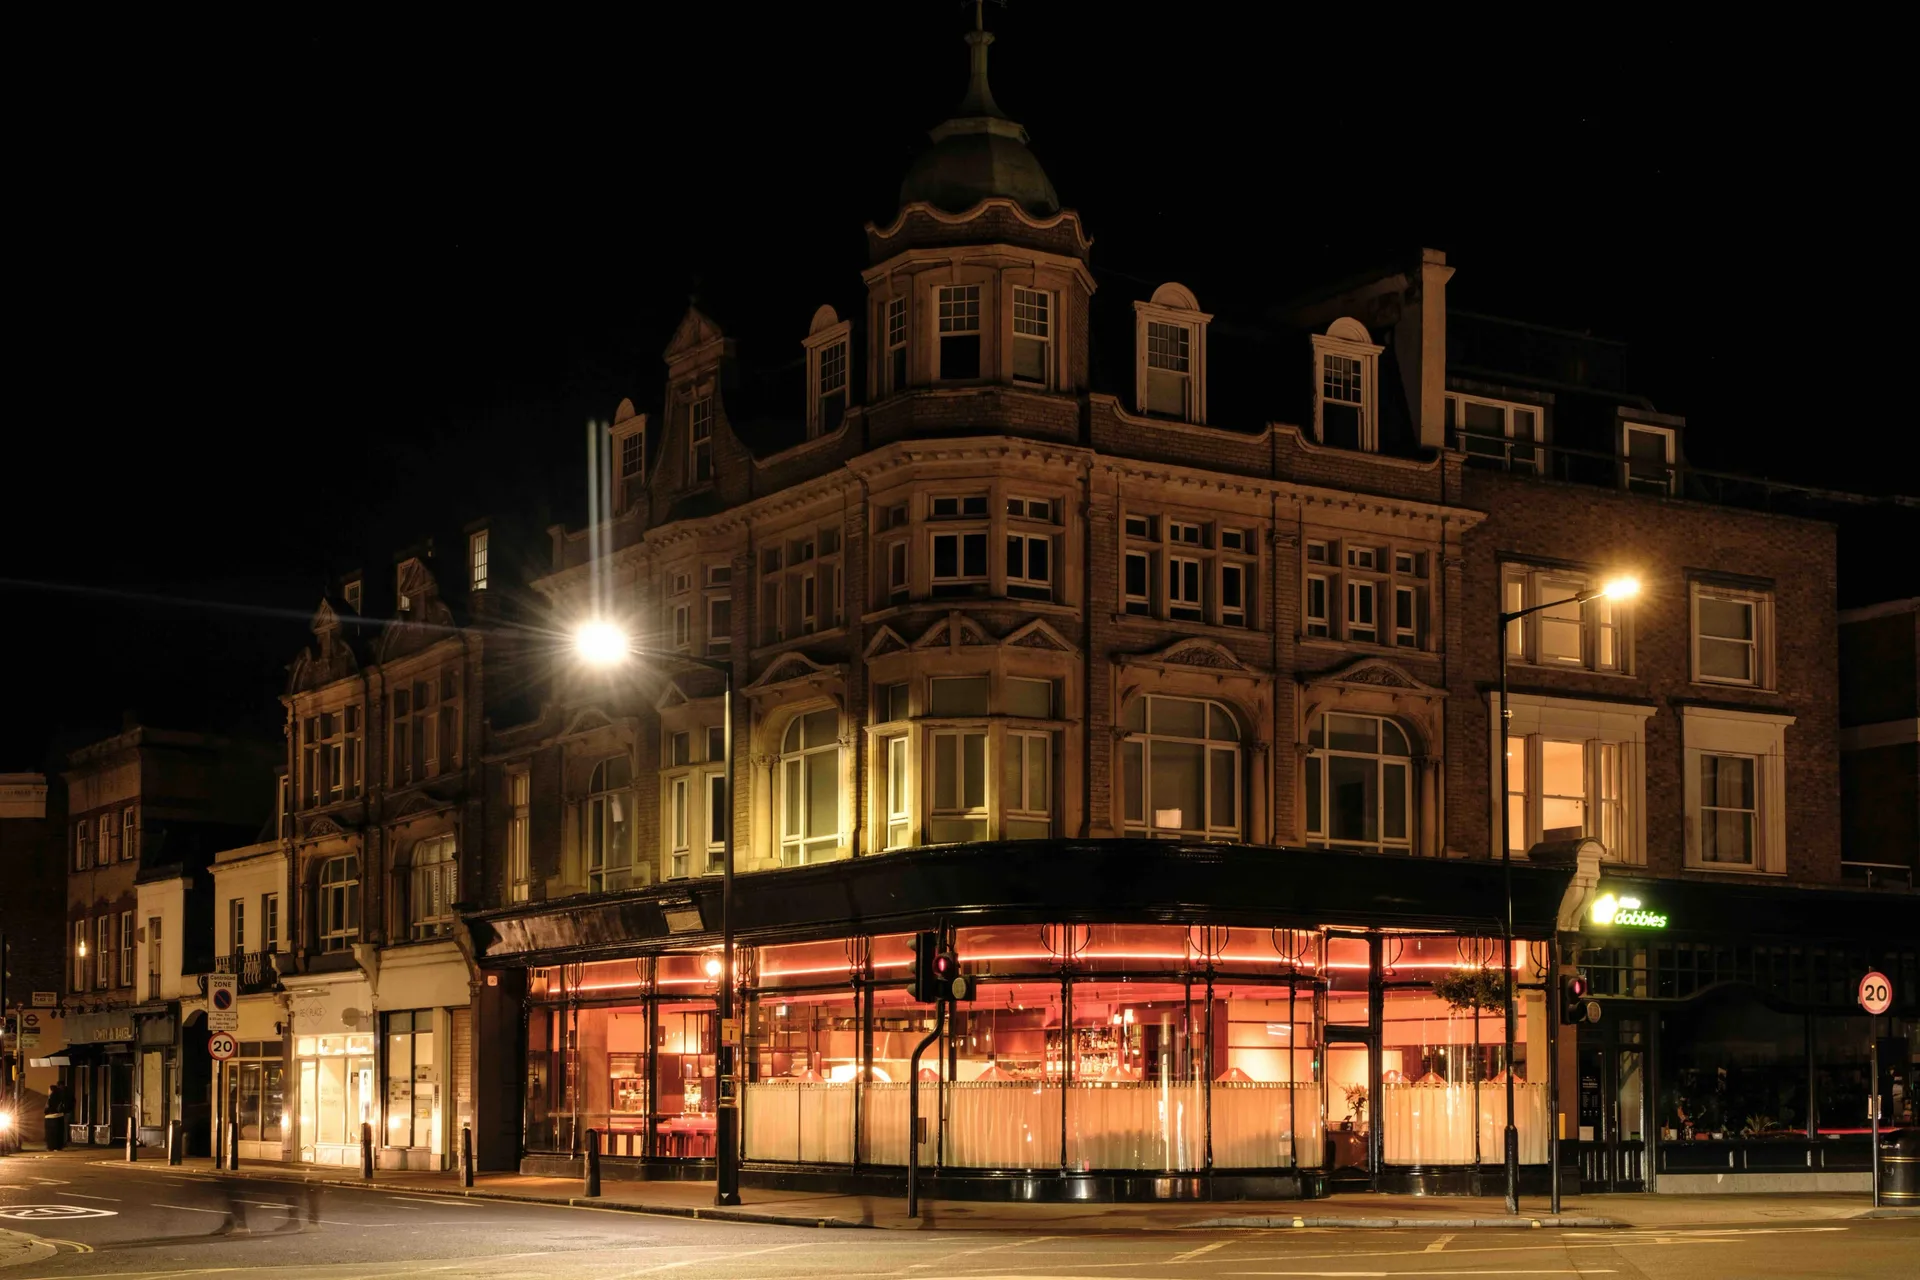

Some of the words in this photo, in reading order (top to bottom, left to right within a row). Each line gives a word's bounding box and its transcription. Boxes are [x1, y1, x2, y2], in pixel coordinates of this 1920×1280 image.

[1615, 910, 1667, 927] dobbies
[1865, 984, 1887, 1002] 20
[213, 1040, 232, 1052] 20
